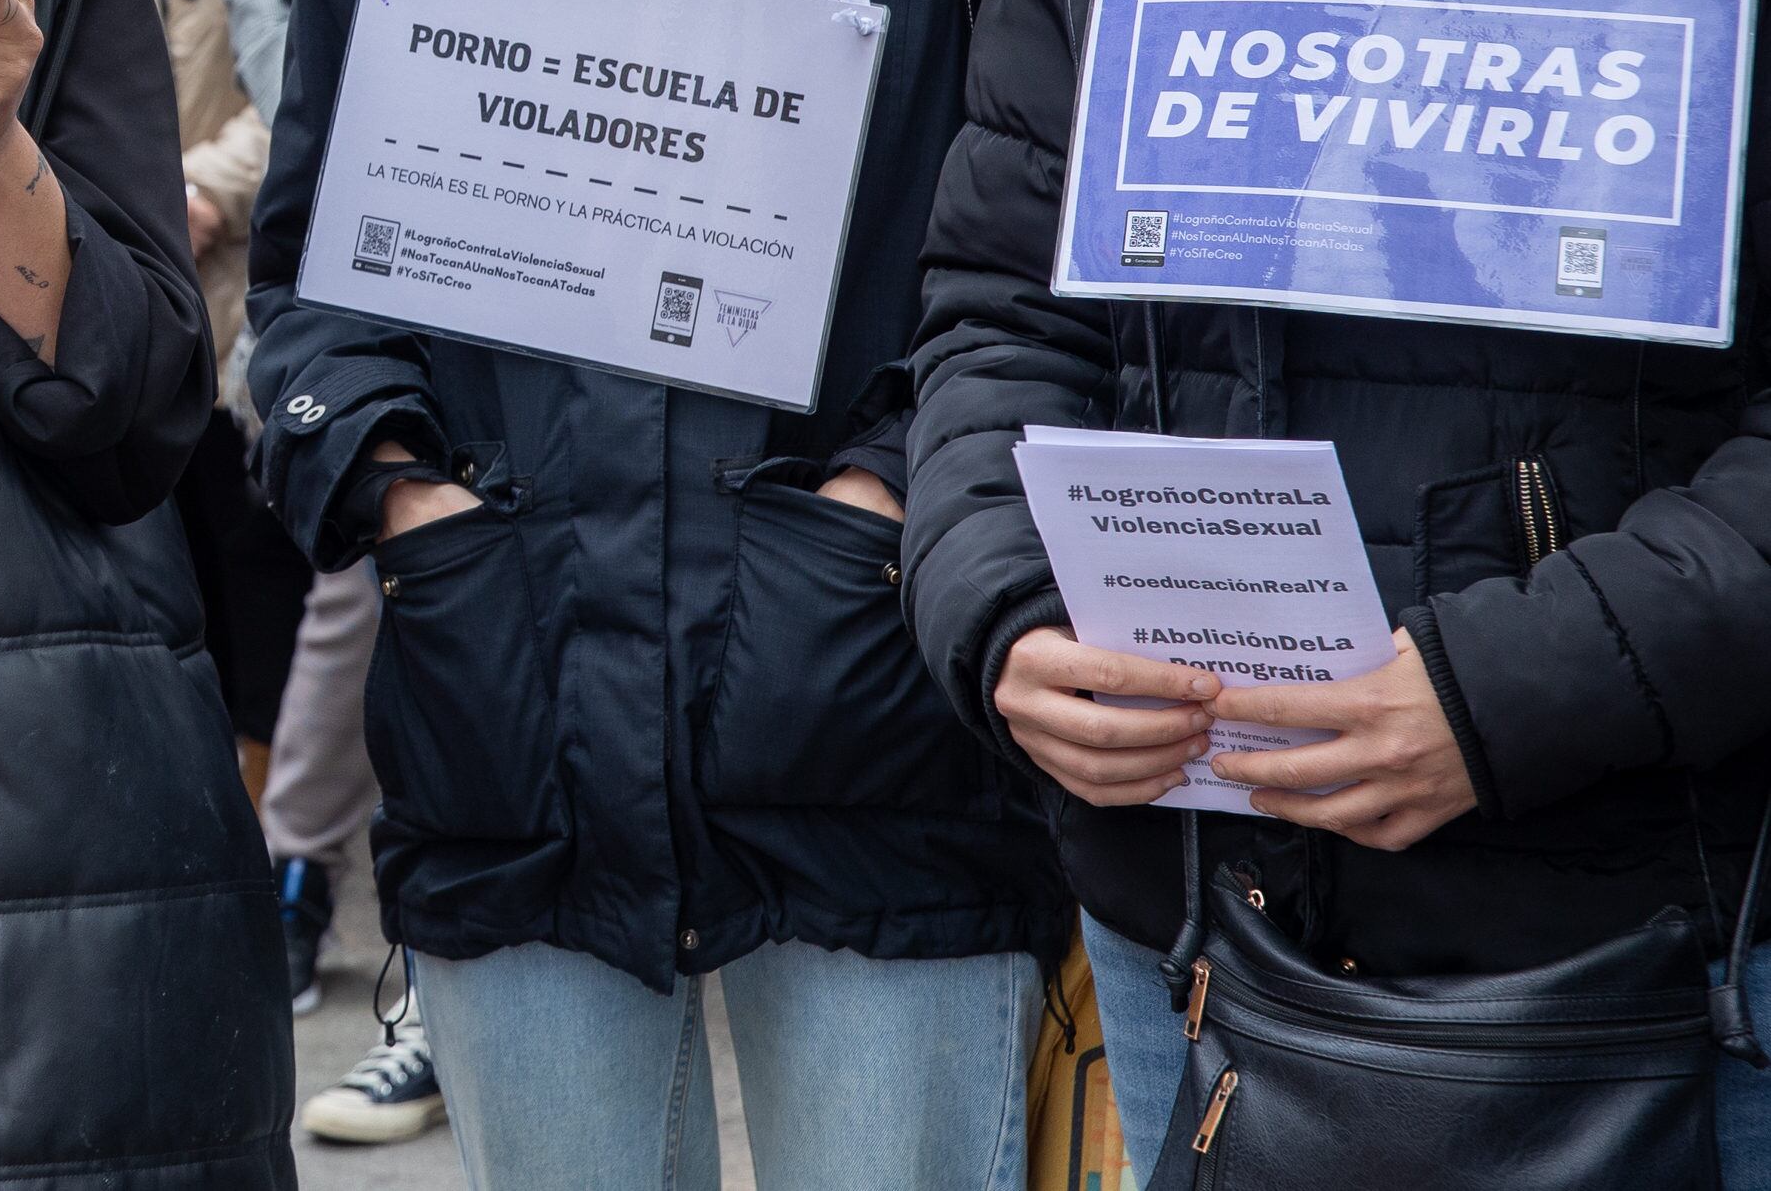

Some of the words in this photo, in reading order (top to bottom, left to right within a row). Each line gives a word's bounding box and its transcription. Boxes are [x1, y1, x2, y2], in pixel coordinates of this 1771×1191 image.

[409, 23, 532, 74] PORNO
[542, 57, 561, 75] =
[573, 54, 740, 114] ESCUELA
[753, 85, 805, 124] DE
[1169, 29, 1646, 102] NOSOTRAS
[477, 92, 706, 163] VIOLADORES
[1147, 90, 1258, 139] DE
[1294, 93, 1657, 167] VIVIRLO
[366, 162, 385, 179] LA
[389, 164, 445, 192] TEORÍA
[448, 177, 469, 195] ES
[474, 181, 490, 199] EL
[494, 186, 551, 211] PORNO
[555, 198, 568, 215] Y
[569, 201, 588, 219] LA
[592, 203, 672, 236] PRÁCTICA
[677, 222, 697, 240] LA
[700, 225, 795, 261] VIOLACIÓN
[1172, 212, 1374, 235] #LogroñoContraLaViolenciaSexual
[1171, 229, 1364, 253] #NosTocanAUnaNosTocanATodas
[404, 227, 606, 280] #LogroñoContraLaViolenciaSexual
[400, 247, 597, 298] #NosTocanAUnaNosTocanATodas
[717, 313, 726, 324] DE
[727, 315, 736, 326] LA
[718, 302, 760, 321] FEMINISTAS
[1067, 484, 1332, 508] #LogroñoContraLa
[1090, 515, 1323, 537] ViolenciaSexual
[1103, 573, 1349, 595] #CoeducaciónRealYa
[1132, 627, 1355, 652] #AboliciónDeLa
[1228, 729, 1291, 746] información
[1230, 744, 1237, 752] y
